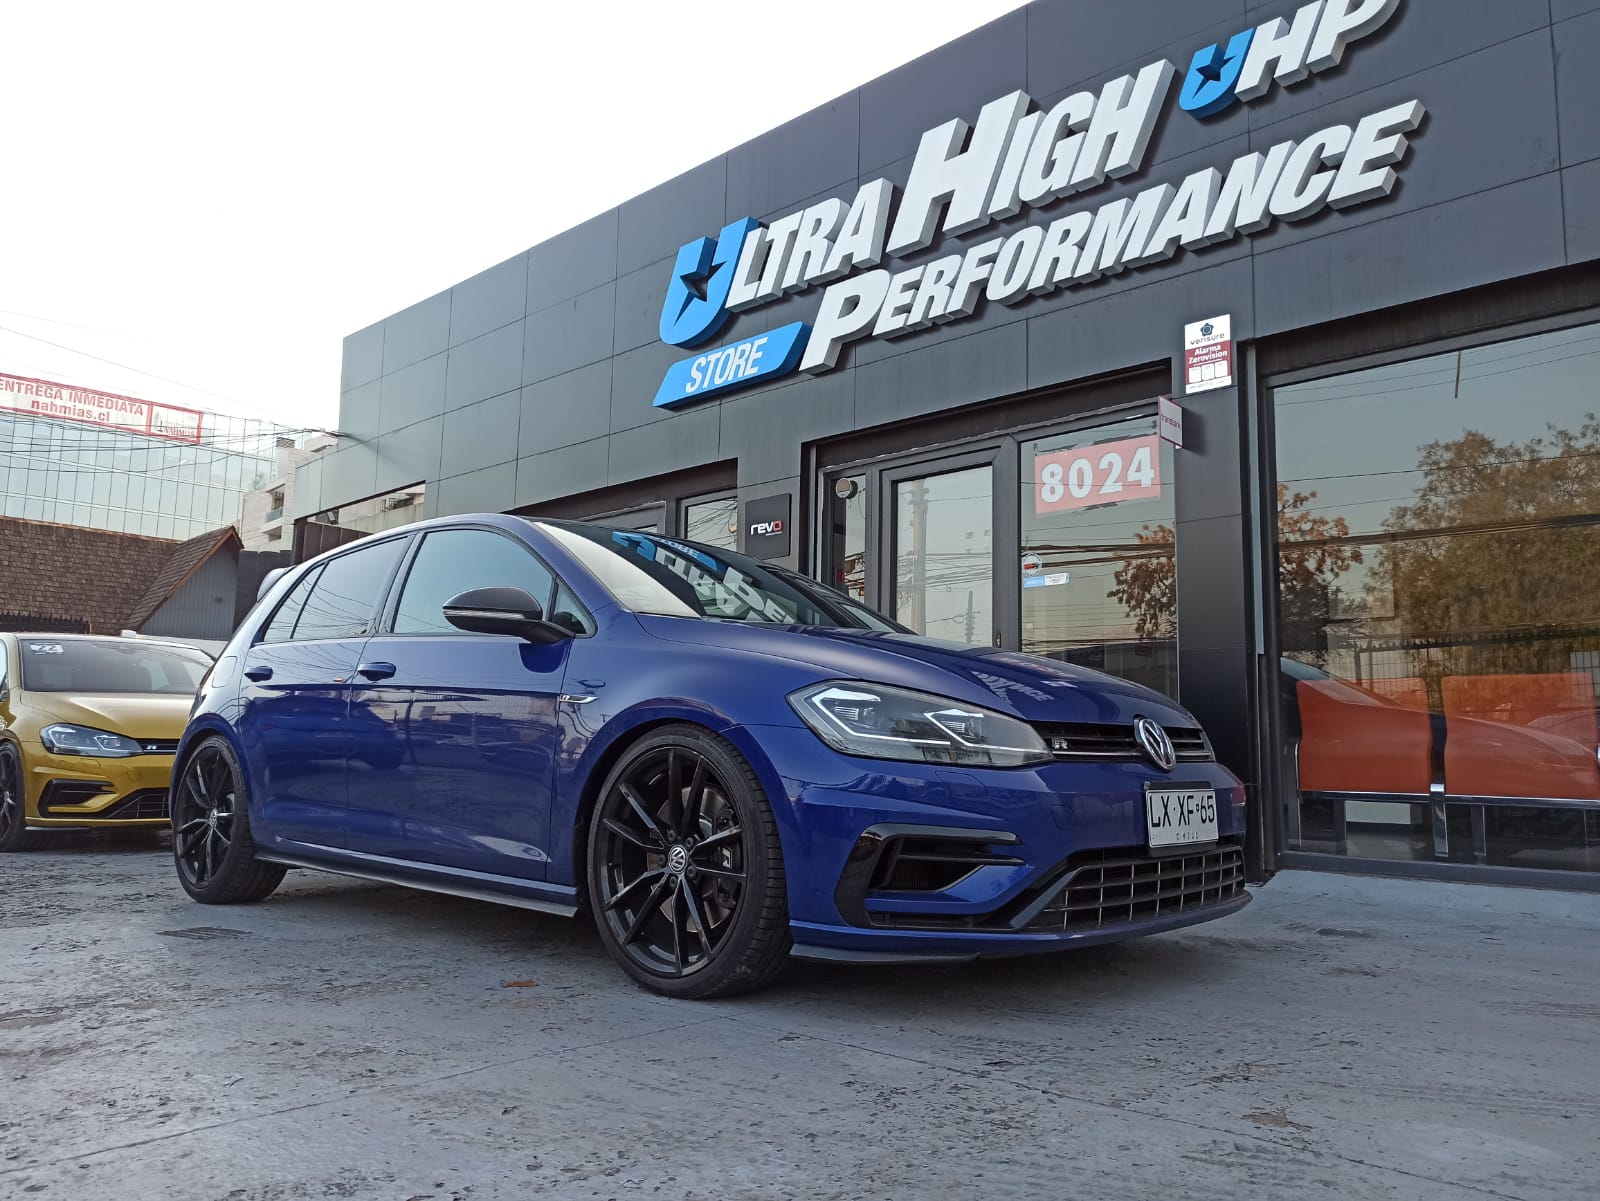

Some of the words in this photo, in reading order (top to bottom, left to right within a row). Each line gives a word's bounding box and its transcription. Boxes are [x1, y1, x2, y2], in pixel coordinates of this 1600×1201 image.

[1179, 0, 1400, 118] UHP
[659, 177, 893, 349] ULTRA
[886, 59, 1175, 254] HIGH
[798, 99, 1426, 375] PERFORMANCE
[1190, 333, 1225, 346] verisure
[1194, 344, 1222, 356] Alarma
[685, 337, 768, 394] STORE
[1188, 350, 1228, 364] Zerovision
[31, 399, 110, 422] nahmias.cl
[68, 391, 144, 416] INMEDIATA
[1041, 446, 1155, 503] 8024
[750, 520, 783, 536] revo
